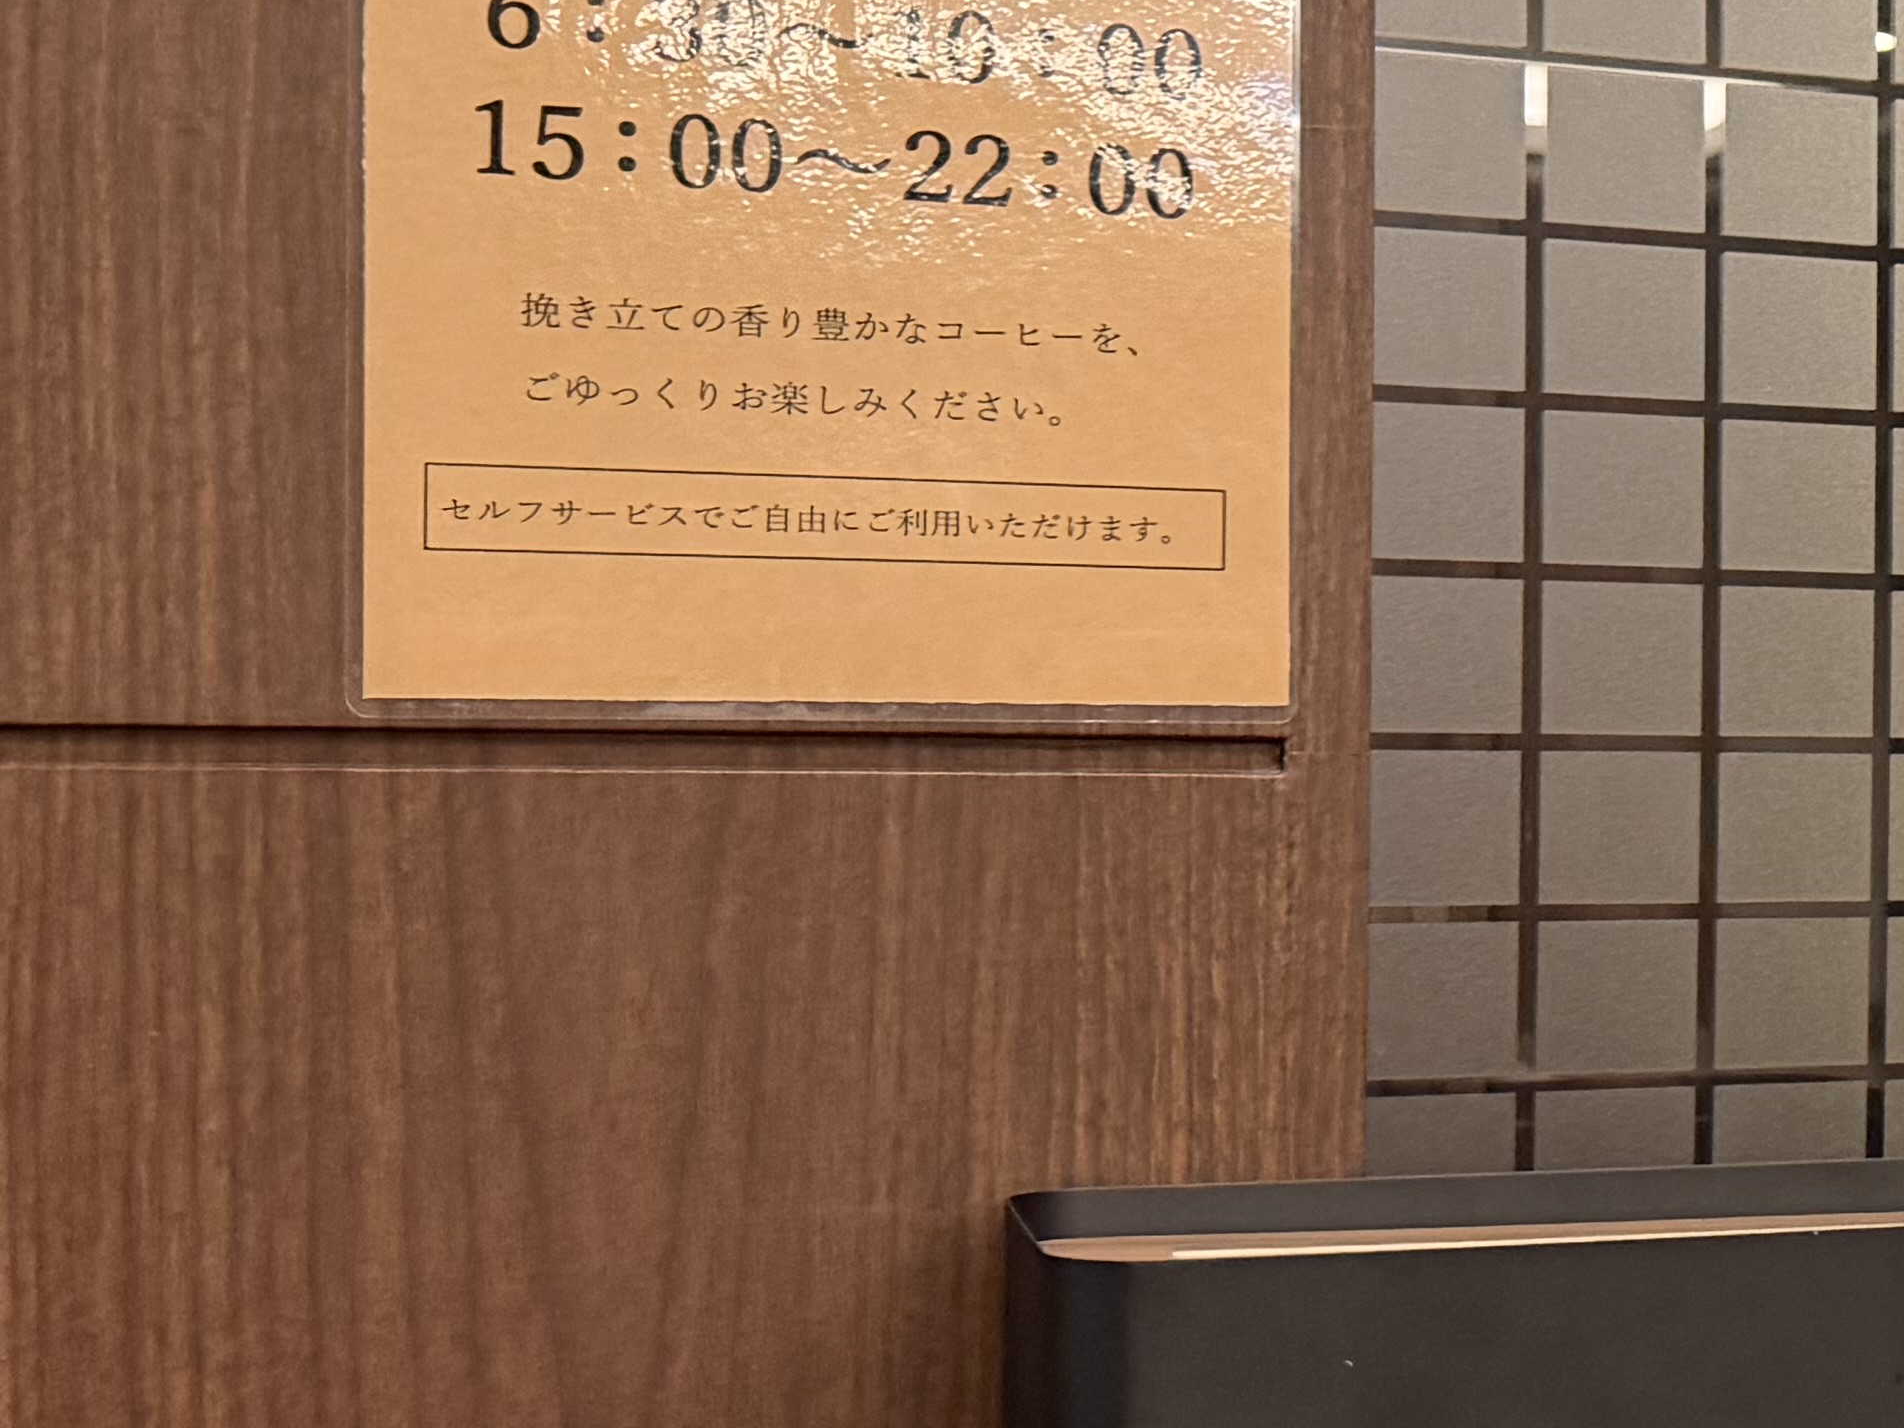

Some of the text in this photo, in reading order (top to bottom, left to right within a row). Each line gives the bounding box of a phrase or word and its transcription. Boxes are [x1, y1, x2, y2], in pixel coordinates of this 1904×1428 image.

[521, 291, 1139, 358] 挽き立ての香り豊かなコーヒーを、
[526, 373, 1065, 428] ごゆっくりお楽しみください。
[442, 495, 1174, 546] セルフサービスでご自由にご利用いただけます。
